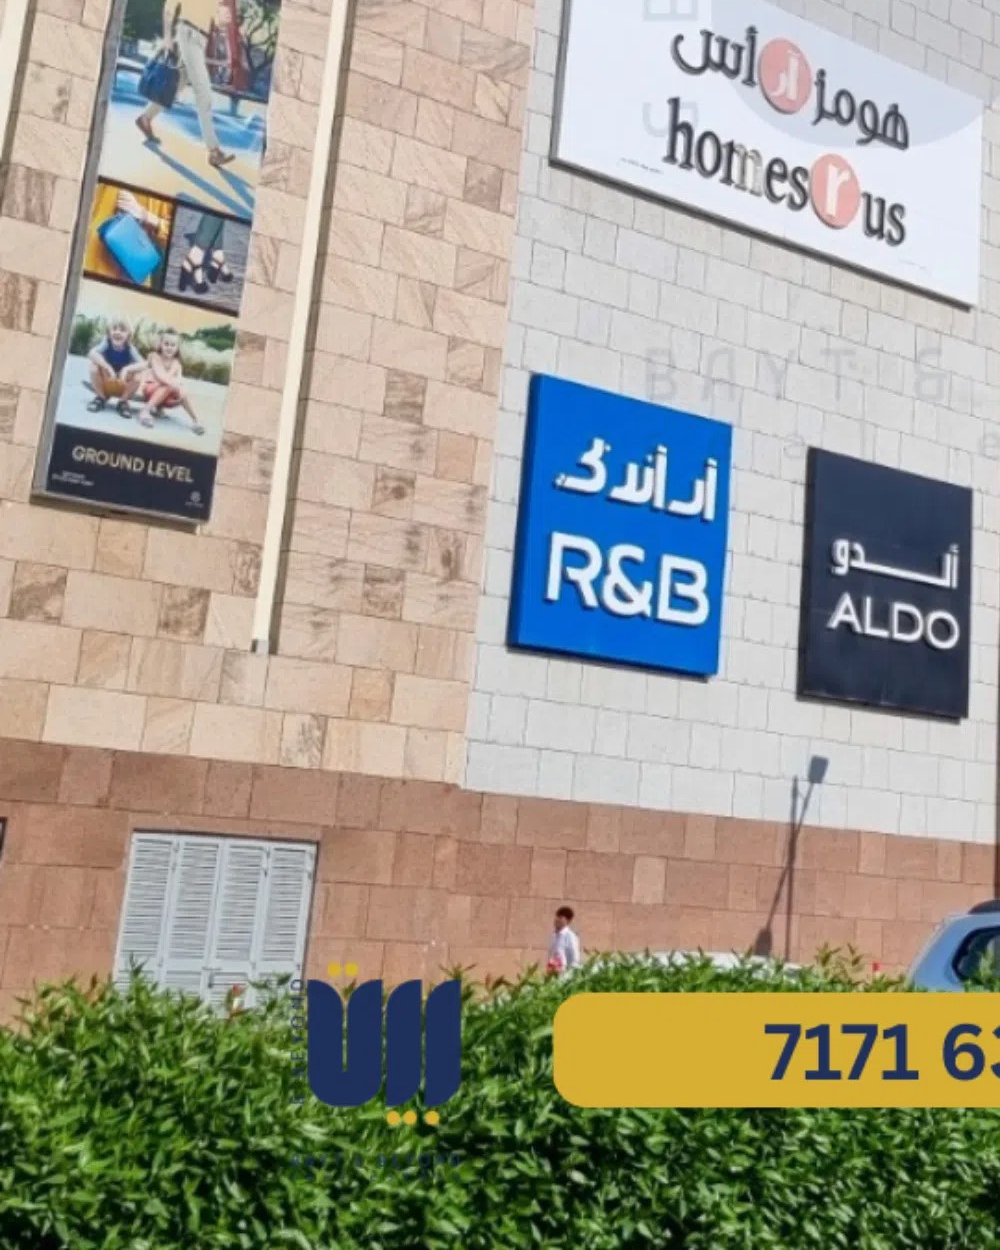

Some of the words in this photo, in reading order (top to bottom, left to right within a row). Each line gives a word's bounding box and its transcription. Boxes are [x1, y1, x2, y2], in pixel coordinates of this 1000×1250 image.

[71, 445, 145, 473] GROUND
[148, 460, 194, 483] LEVEL
[545, 531, 711, 627] R&B
[826, 592, 960, 651] ALDO
